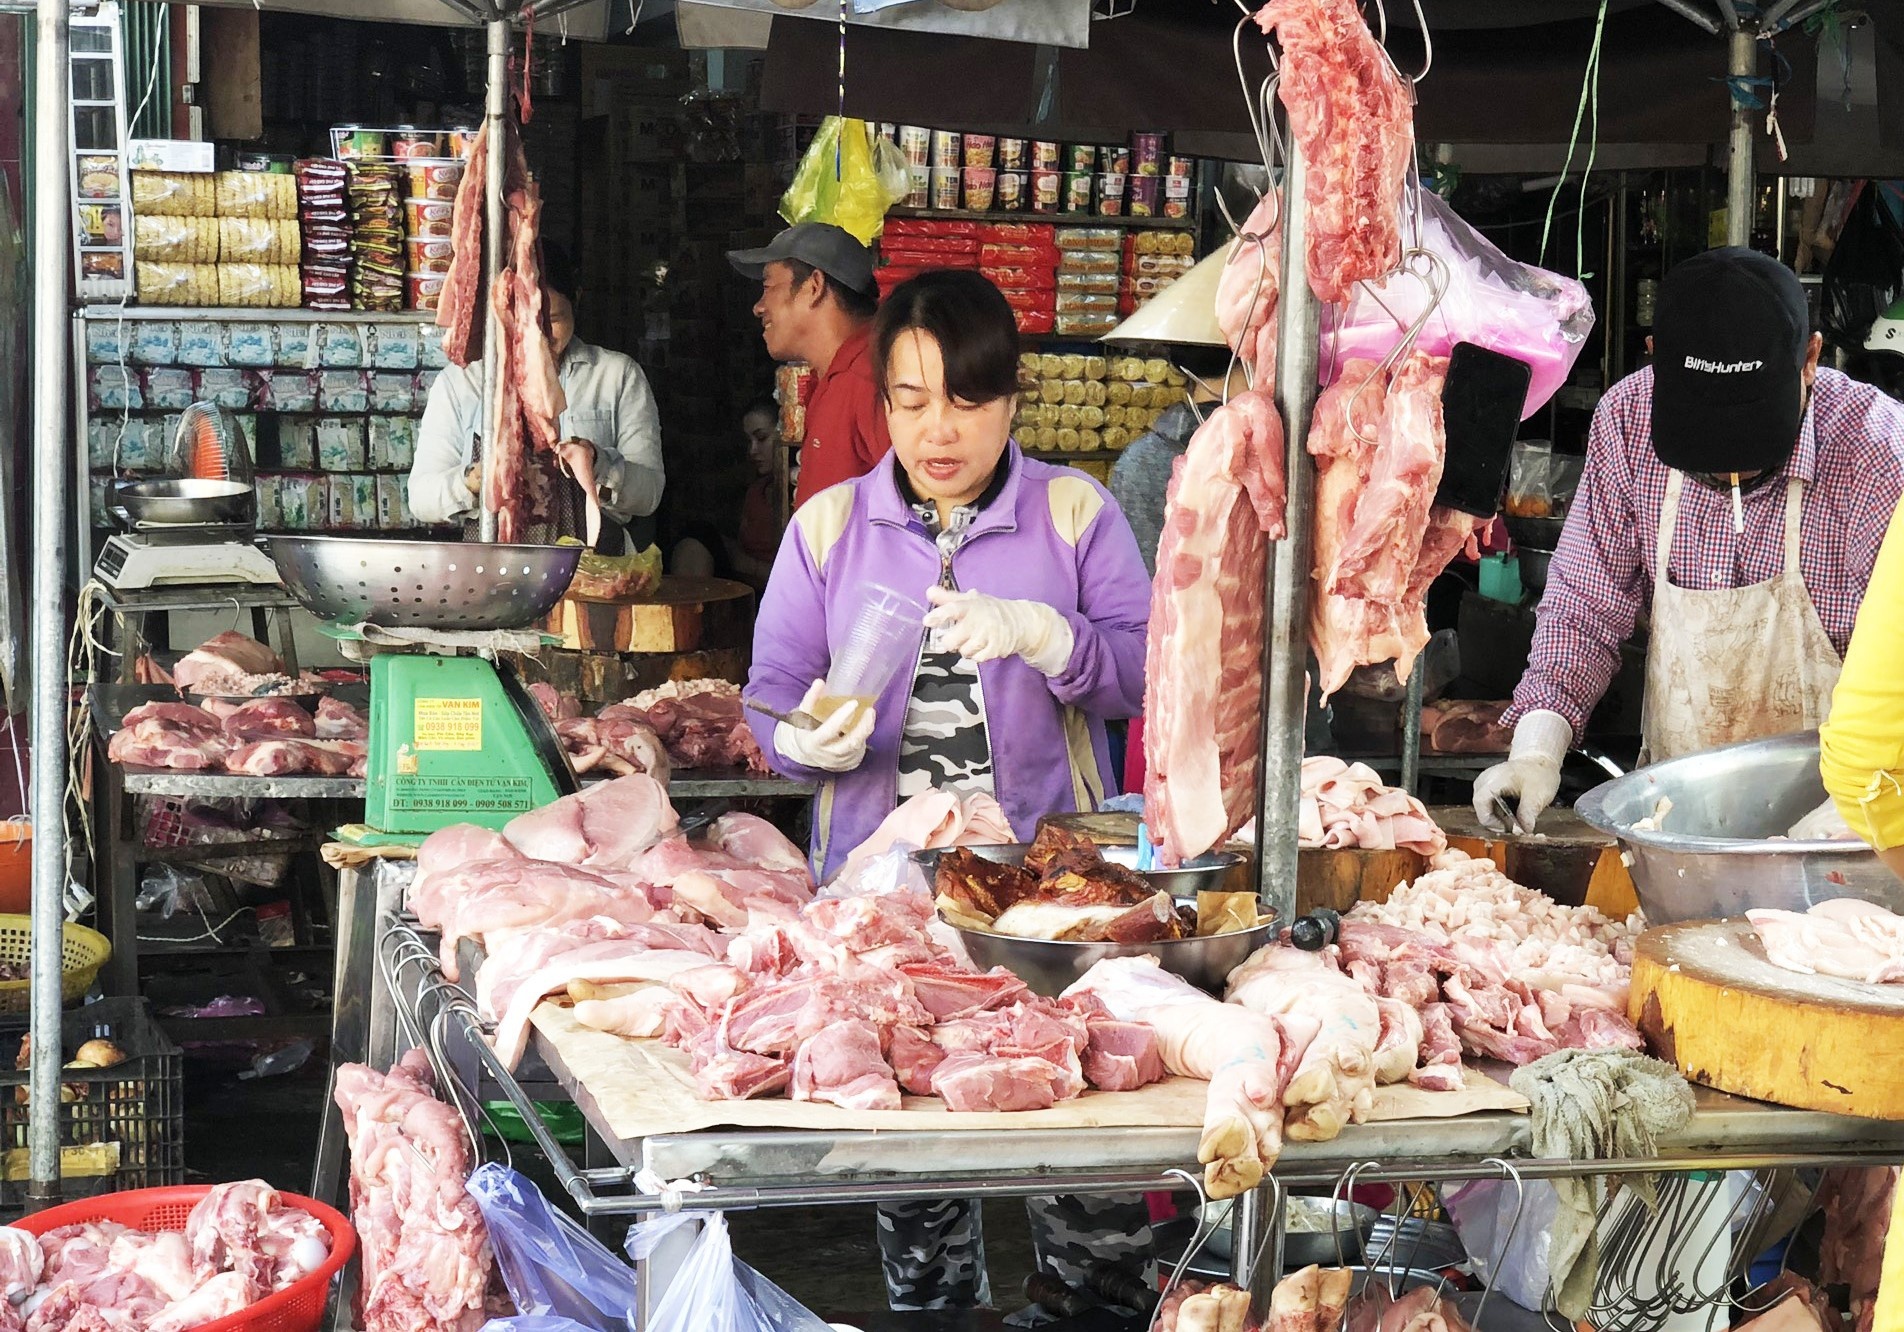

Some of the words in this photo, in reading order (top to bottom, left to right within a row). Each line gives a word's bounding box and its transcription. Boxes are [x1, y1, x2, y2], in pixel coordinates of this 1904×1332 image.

[418, 778, 426, 786] TY
[413, 799, 433, 808] 0938
[435, 799, 450, 808] 918
[452, 799, 467, 808] 099
[475, 800, 495, 809] 0909
[497, 800, 512, 809] 508
[514, 800, 528, 809] 571
